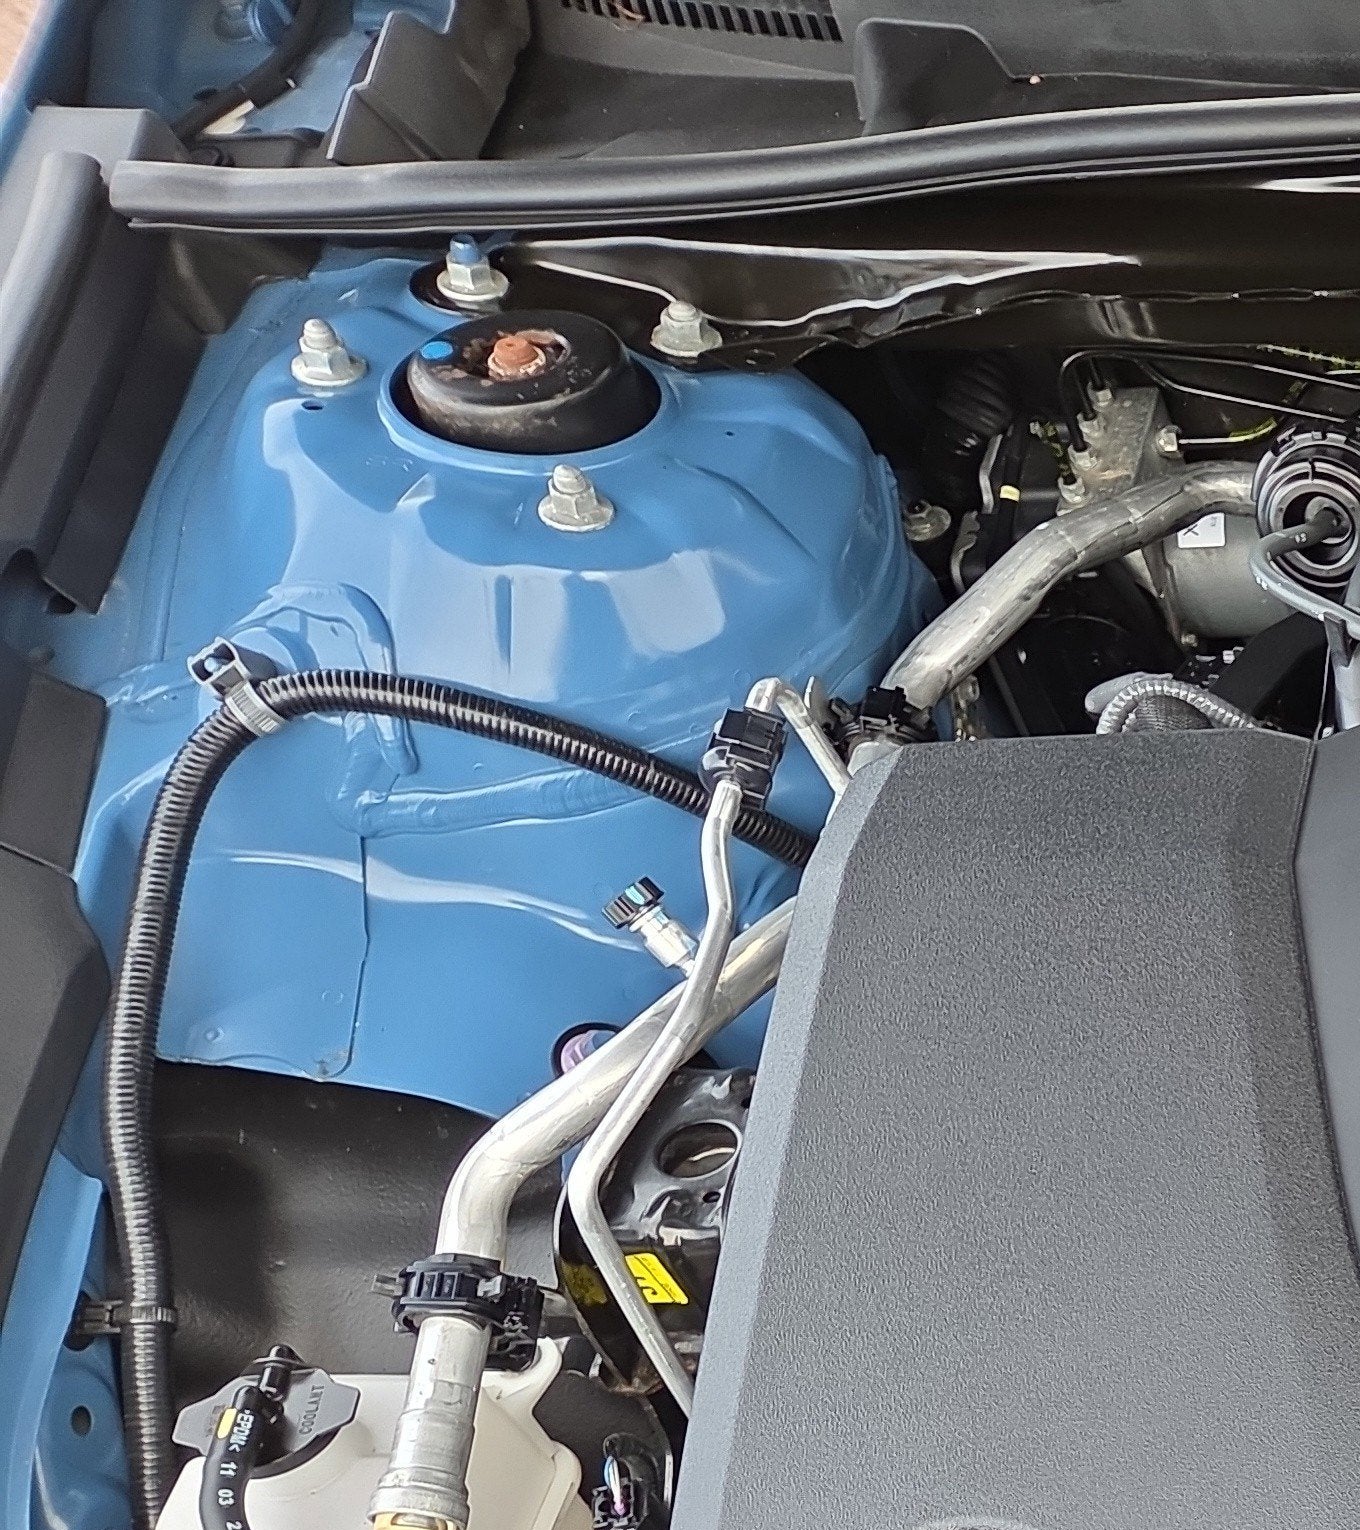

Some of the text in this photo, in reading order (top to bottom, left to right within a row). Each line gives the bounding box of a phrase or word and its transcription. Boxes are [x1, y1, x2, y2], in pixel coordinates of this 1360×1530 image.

[300, 1384, 325, 1436] COOLANT
[219, 1461, 238, 1477] 11
[217, 1488, 235, 1507] 03
